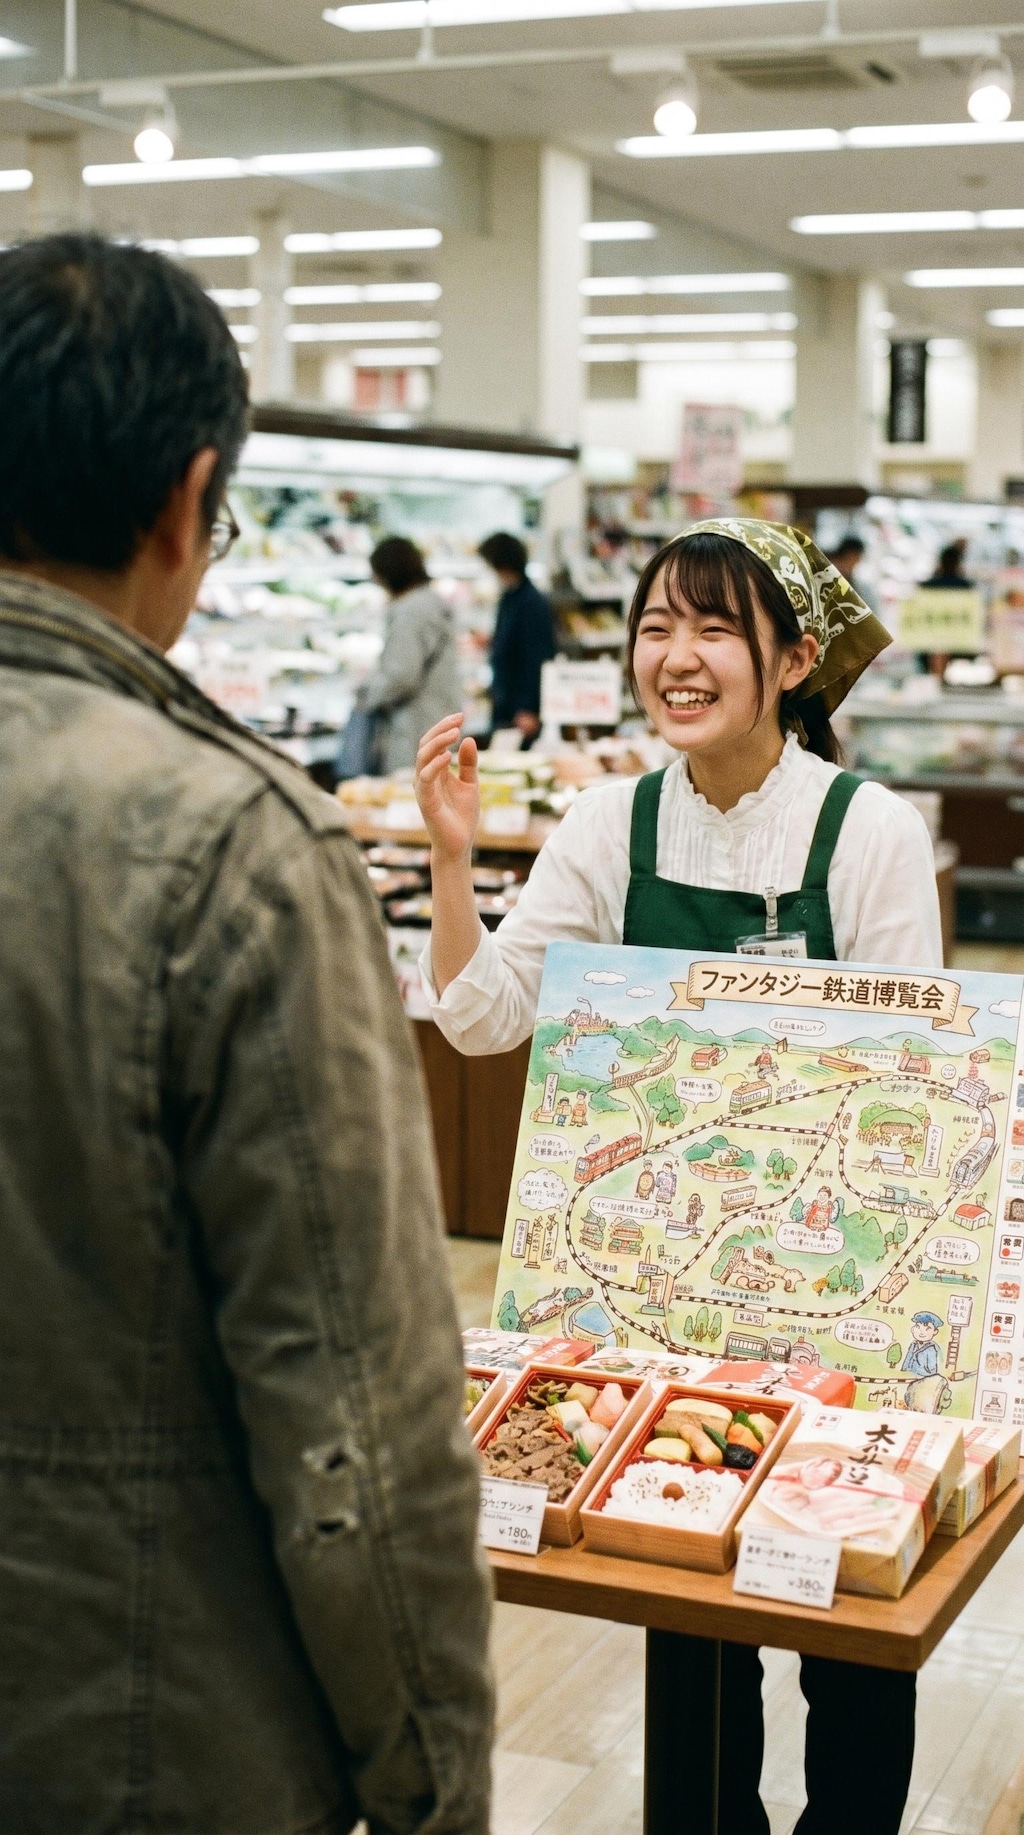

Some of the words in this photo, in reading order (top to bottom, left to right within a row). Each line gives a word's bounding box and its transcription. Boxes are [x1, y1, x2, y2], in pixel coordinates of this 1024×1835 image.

[700, 969, 946, 1012] ファンタジー鉄道博覧会
